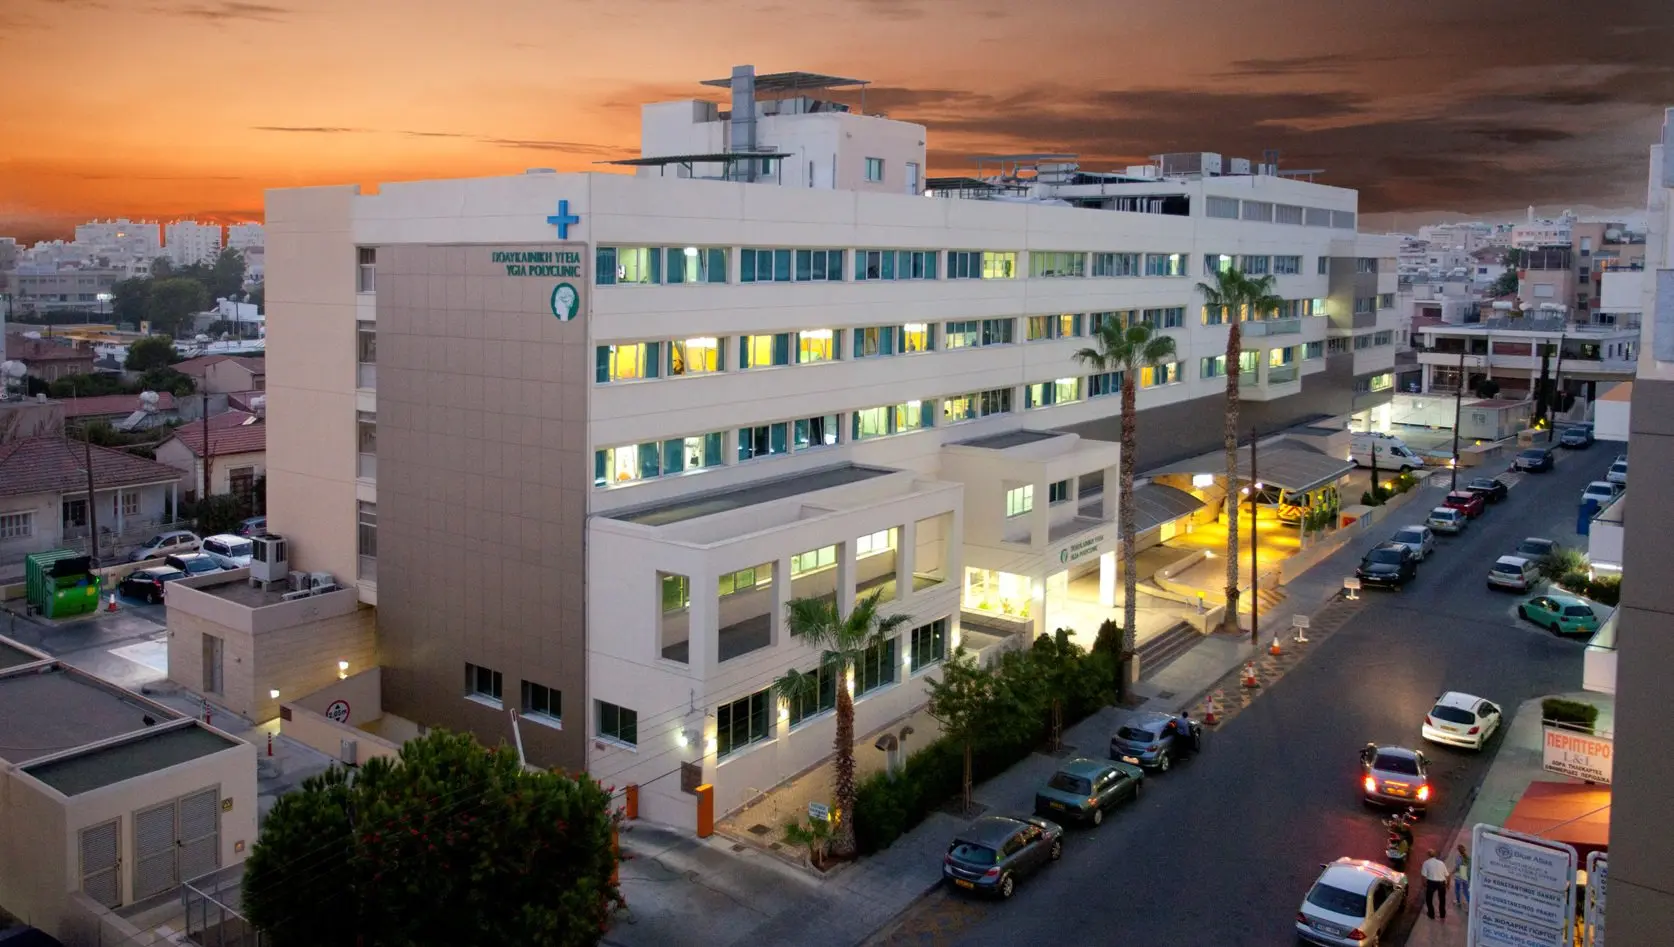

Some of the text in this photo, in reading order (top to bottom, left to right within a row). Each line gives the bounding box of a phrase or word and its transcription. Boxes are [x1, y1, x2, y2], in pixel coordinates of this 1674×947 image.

[554, 251, 580, 263] ΥΓΕΙΑ
[506, 265, 581, 277] YGIA POLYCLINIC
[1547, 732, 1610, 758] ΠΕΡΙΠΤΕΡΟ
